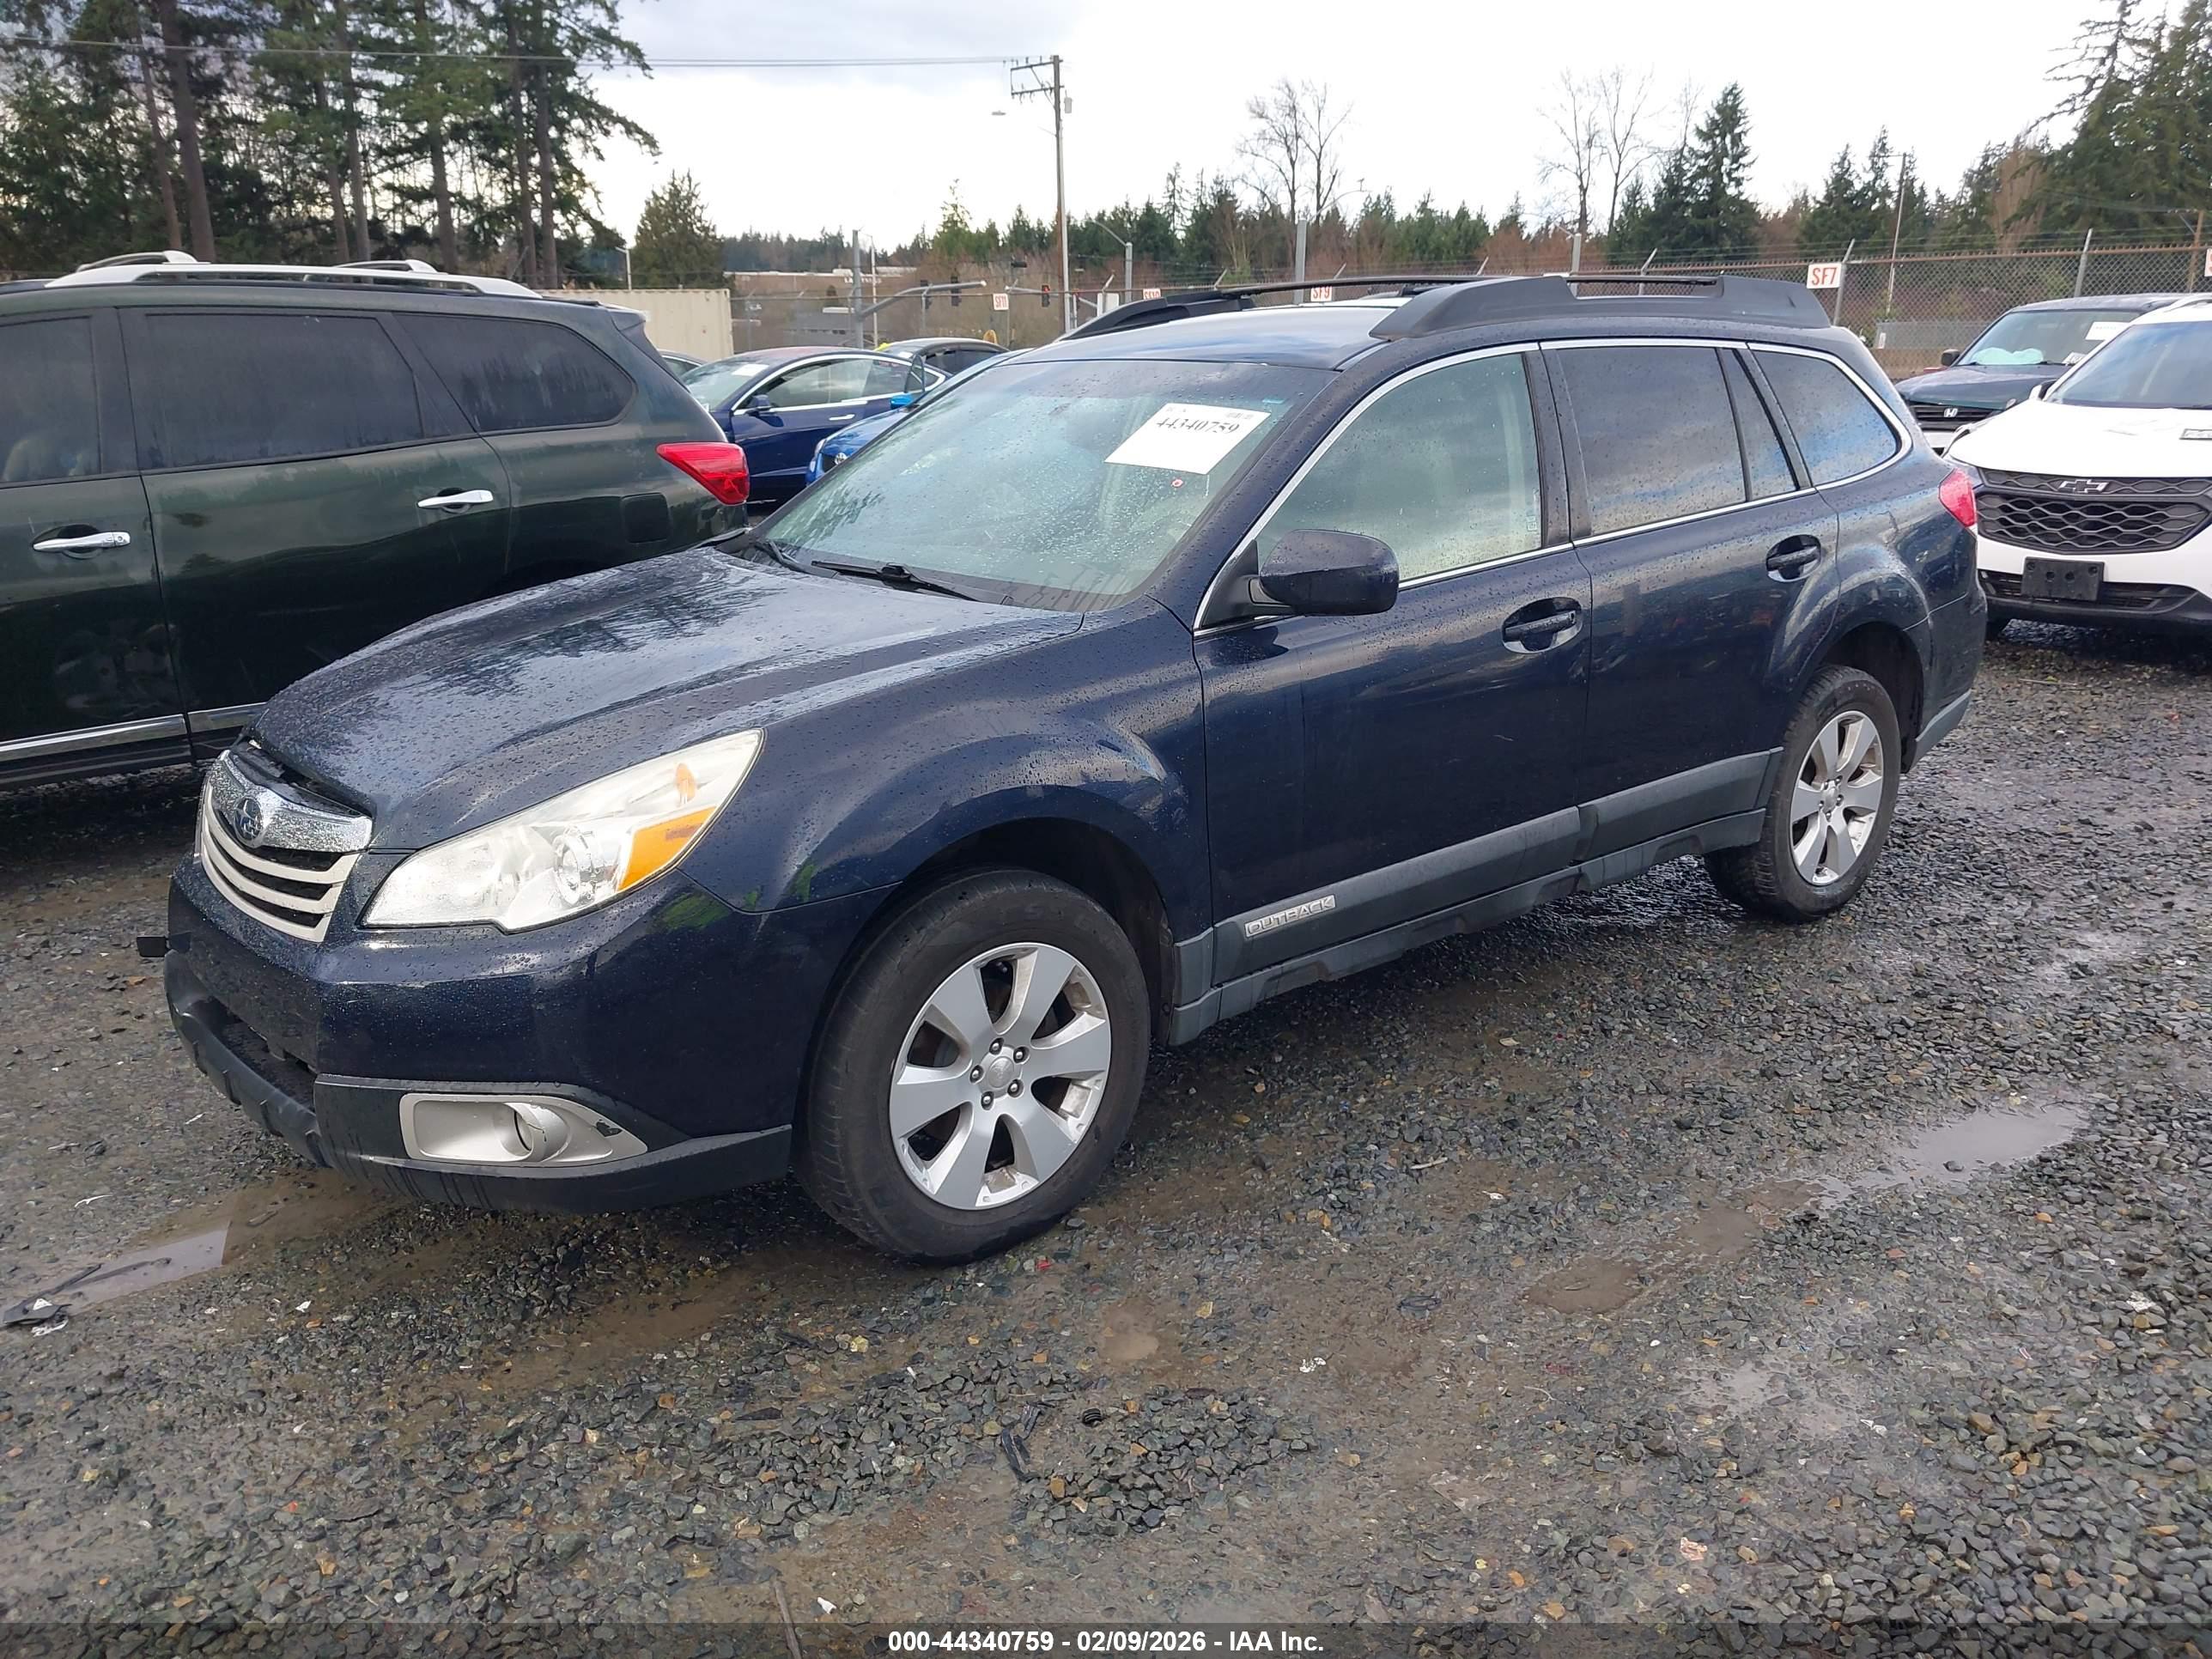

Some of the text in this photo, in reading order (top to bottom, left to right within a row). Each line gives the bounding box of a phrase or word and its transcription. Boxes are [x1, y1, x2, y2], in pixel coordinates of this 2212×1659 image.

[1811, 267, 1838, 286] SF7
[1156, 417, 1240, 434] 44340759
[1247, 896, 1333, 935] OUTBACK
